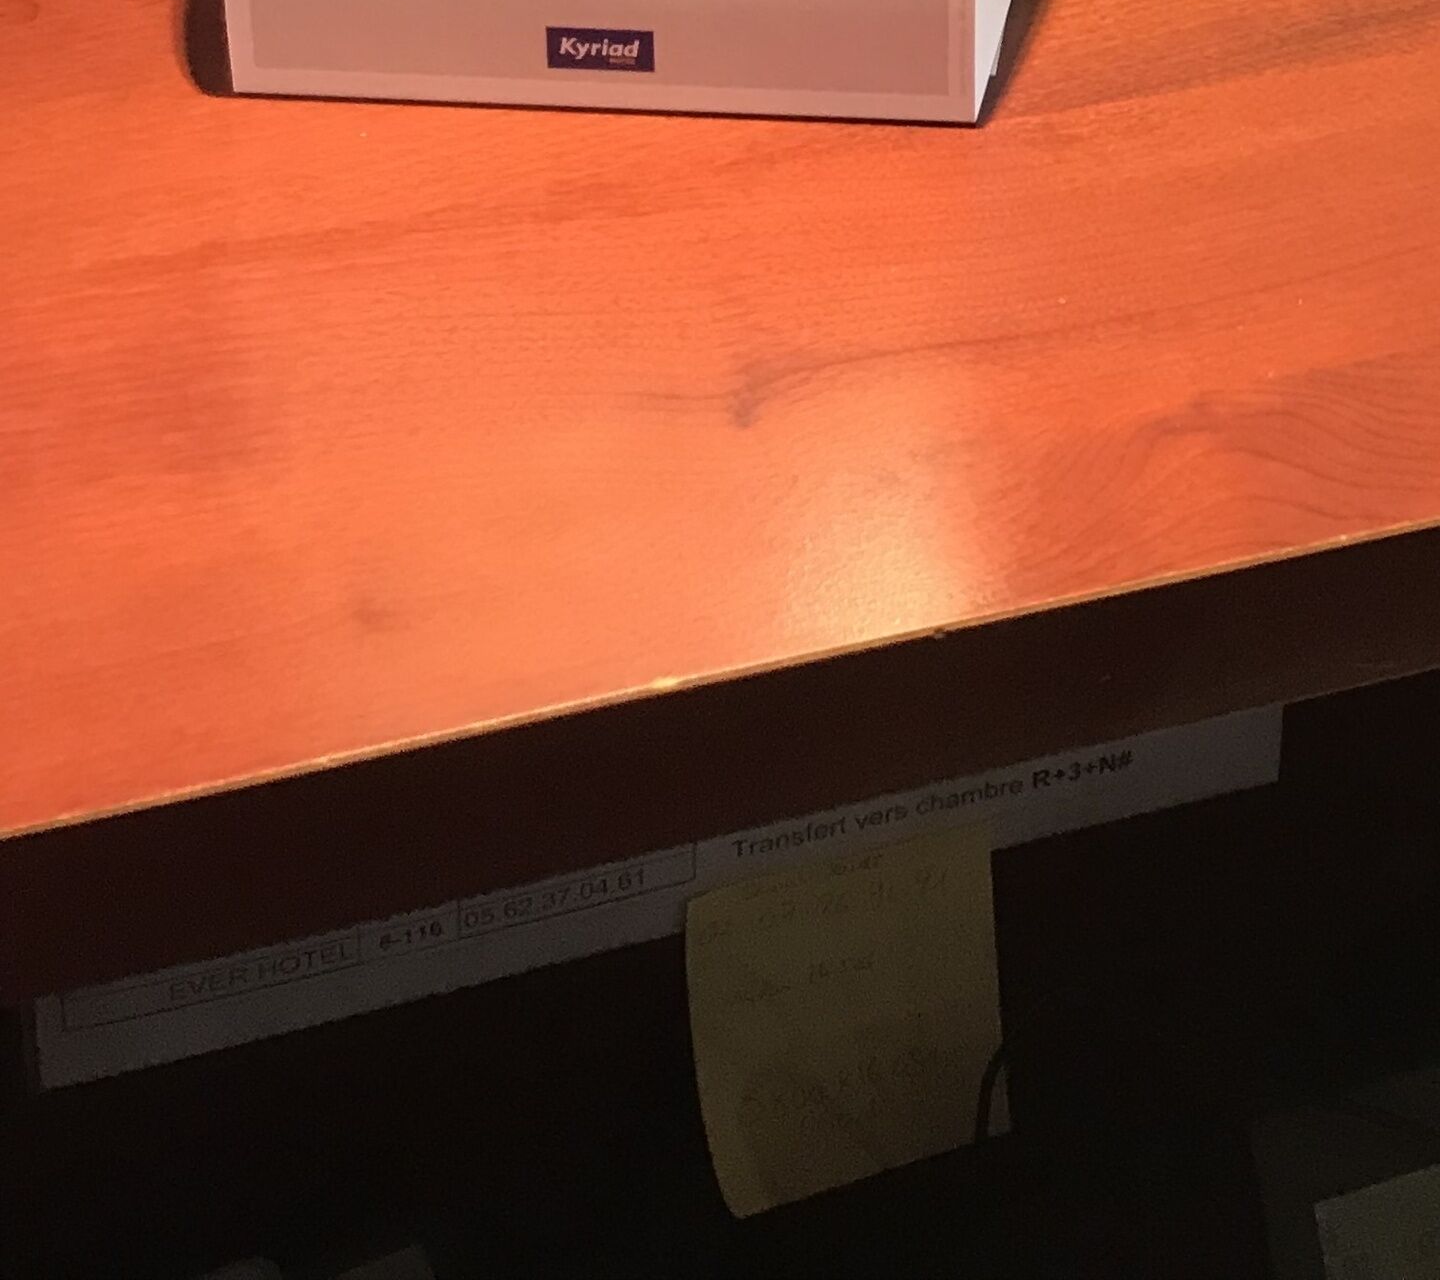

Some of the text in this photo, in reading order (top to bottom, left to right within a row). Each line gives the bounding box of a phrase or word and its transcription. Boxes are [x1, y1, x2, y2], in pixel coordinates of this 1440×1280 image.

[558, 36, 641, 60] Kyriad
[733, 748, 1135, 858] Transfert vers chambre R+3+N#
[168, 965, 250, 1002] EVER
[257, 941, 356, 981] HOTEL
